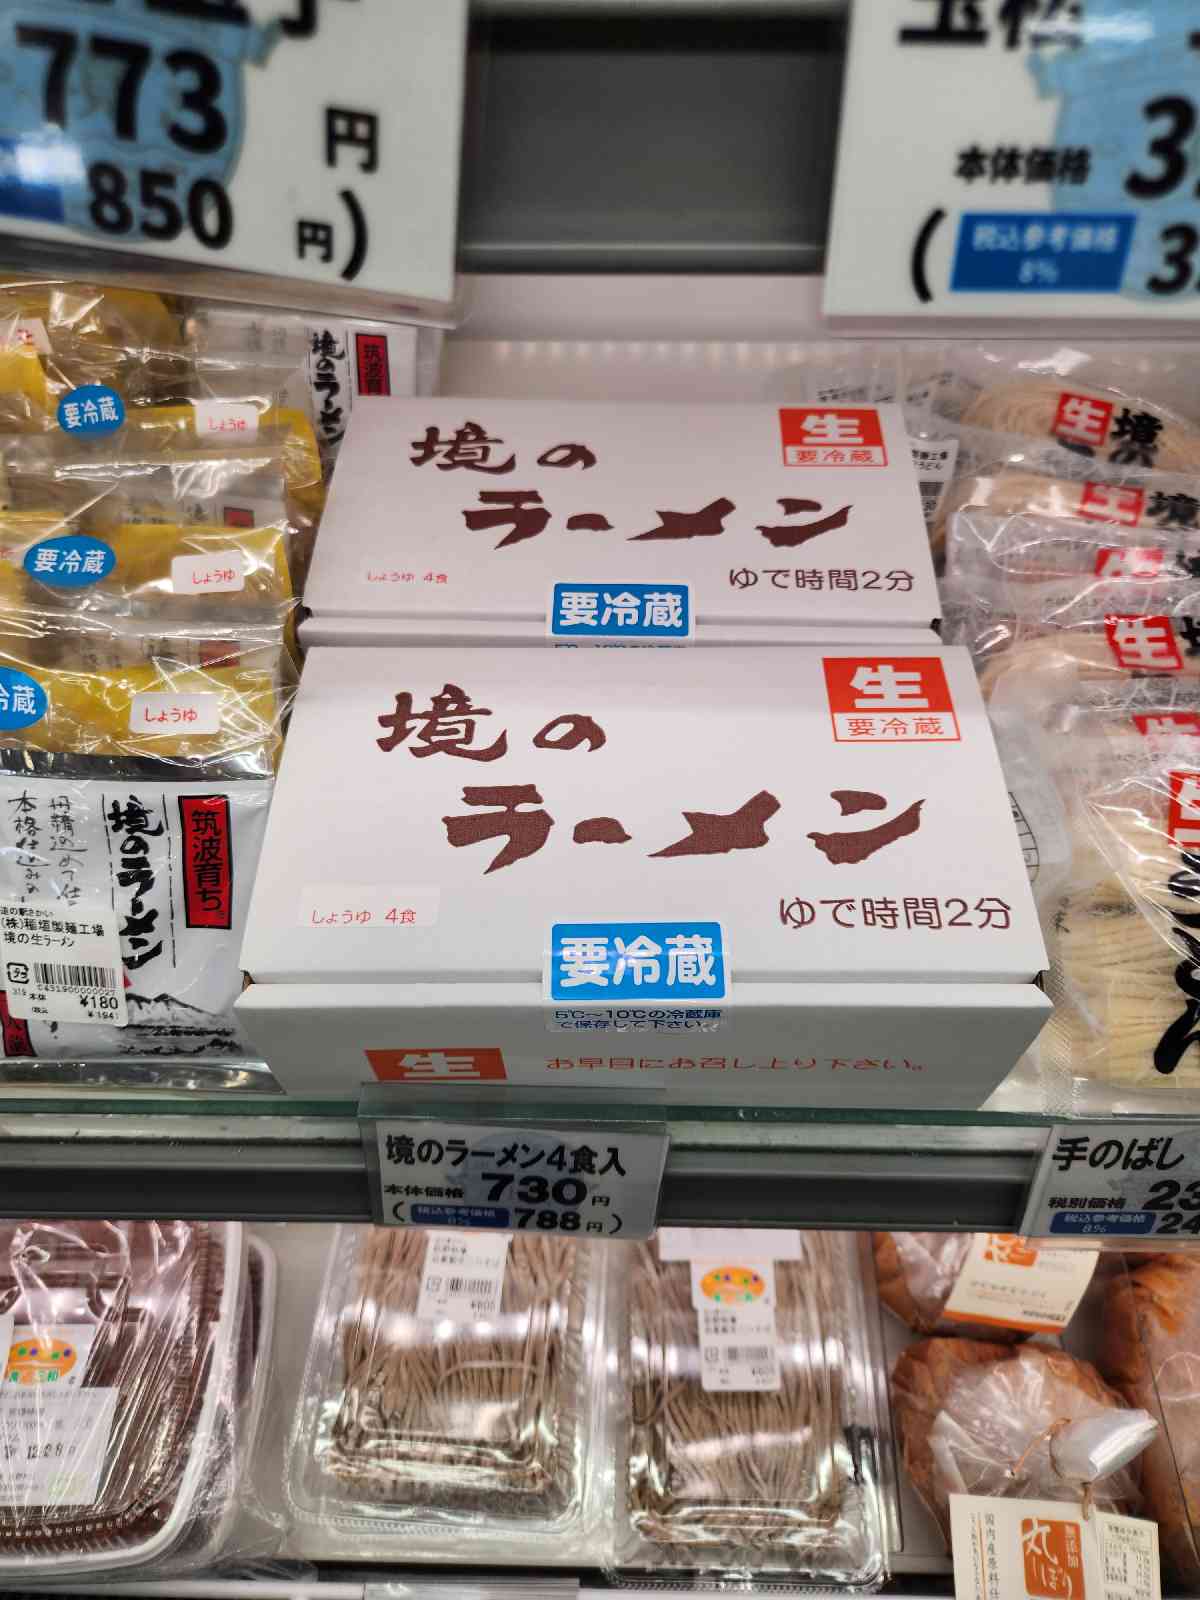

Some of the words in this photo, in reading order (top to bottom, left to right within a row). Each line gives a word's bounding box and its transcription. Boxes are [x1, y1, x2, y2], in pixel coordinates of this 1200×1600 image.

[15, 23, 228, 154] 773
[324, 106, 378, 174] 円
[87, 162, 233, 249] 850
[64, 396, 120, 428] 要冷蔵
[208, 417, 248, 432] しょうゆ
[800, 413, 865, 445] 生
[1058, 397, 1109, 443] 生
[410, 422, 598, 474] 境の
[796, 450, 876, 464] 要冷蔵
[461, 490, 853, 550] ラーメン
[35, 549, 106, 575] 要冷蔵
[192, 569, 236, 586] しょうゆ
[366, 572, 415, 584] しょうゆ
[729, 568, 914, 593] ゆで時間2分
[560, 591, 684, 627] 要冷蔵
[1111, 616, 1180, 668] 生
[851, 665, 931, 709] 生
[144, 706, 198, 723] しょうゆ
[376, 683, 606, 762] 境の
[847, 716, 945, 738] 要冷蔵
[443, 784, 925, 875] ラーメン
[190, 810, 223, 912] 筑波育ち
[107, 794, 165, 970] 境のラーメン
[310, 908, 371, 926] しょうゆ
[385, 908, 418, 926] 4食
[779, 896, 1012, 930] ゆで時間2分
[559, 934, 719, 988] 要冷蔵
[398, 1051, 481, 1078] 生
[385, 1134, 626, 1177] 境のラーメン4食入
[1052, 1136, 1185, 1171] 手のばし
[384, 1183, 464, 1199] 本体価格
